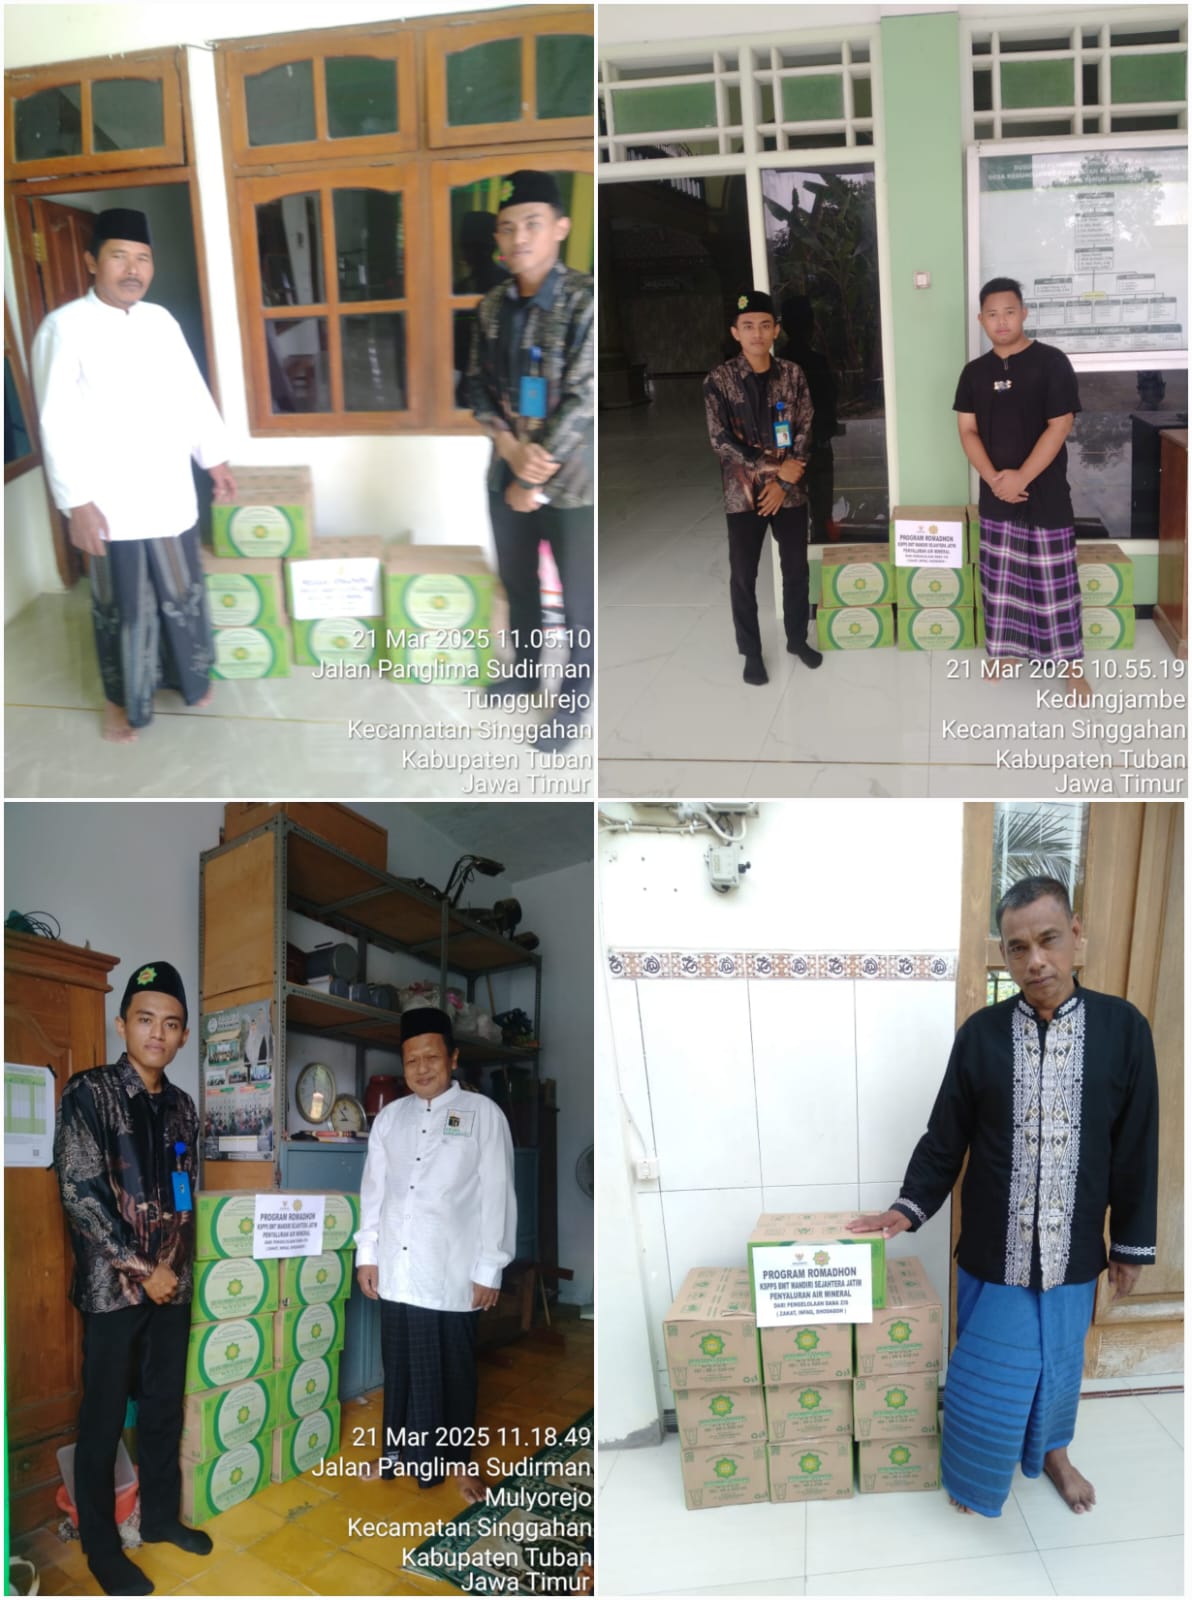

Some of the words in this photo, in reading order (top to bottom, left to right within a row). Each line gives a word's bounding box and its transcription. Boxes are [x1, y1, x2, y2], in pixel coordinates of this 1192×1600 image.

[763, 1269, 805, 1279] PROGRAM
[808, 1267, 856, 1278] ROMADHON
[770, 1291, 810, 1300] PENYALURAN
[825, 1289, 851, 1297] MINERAL
